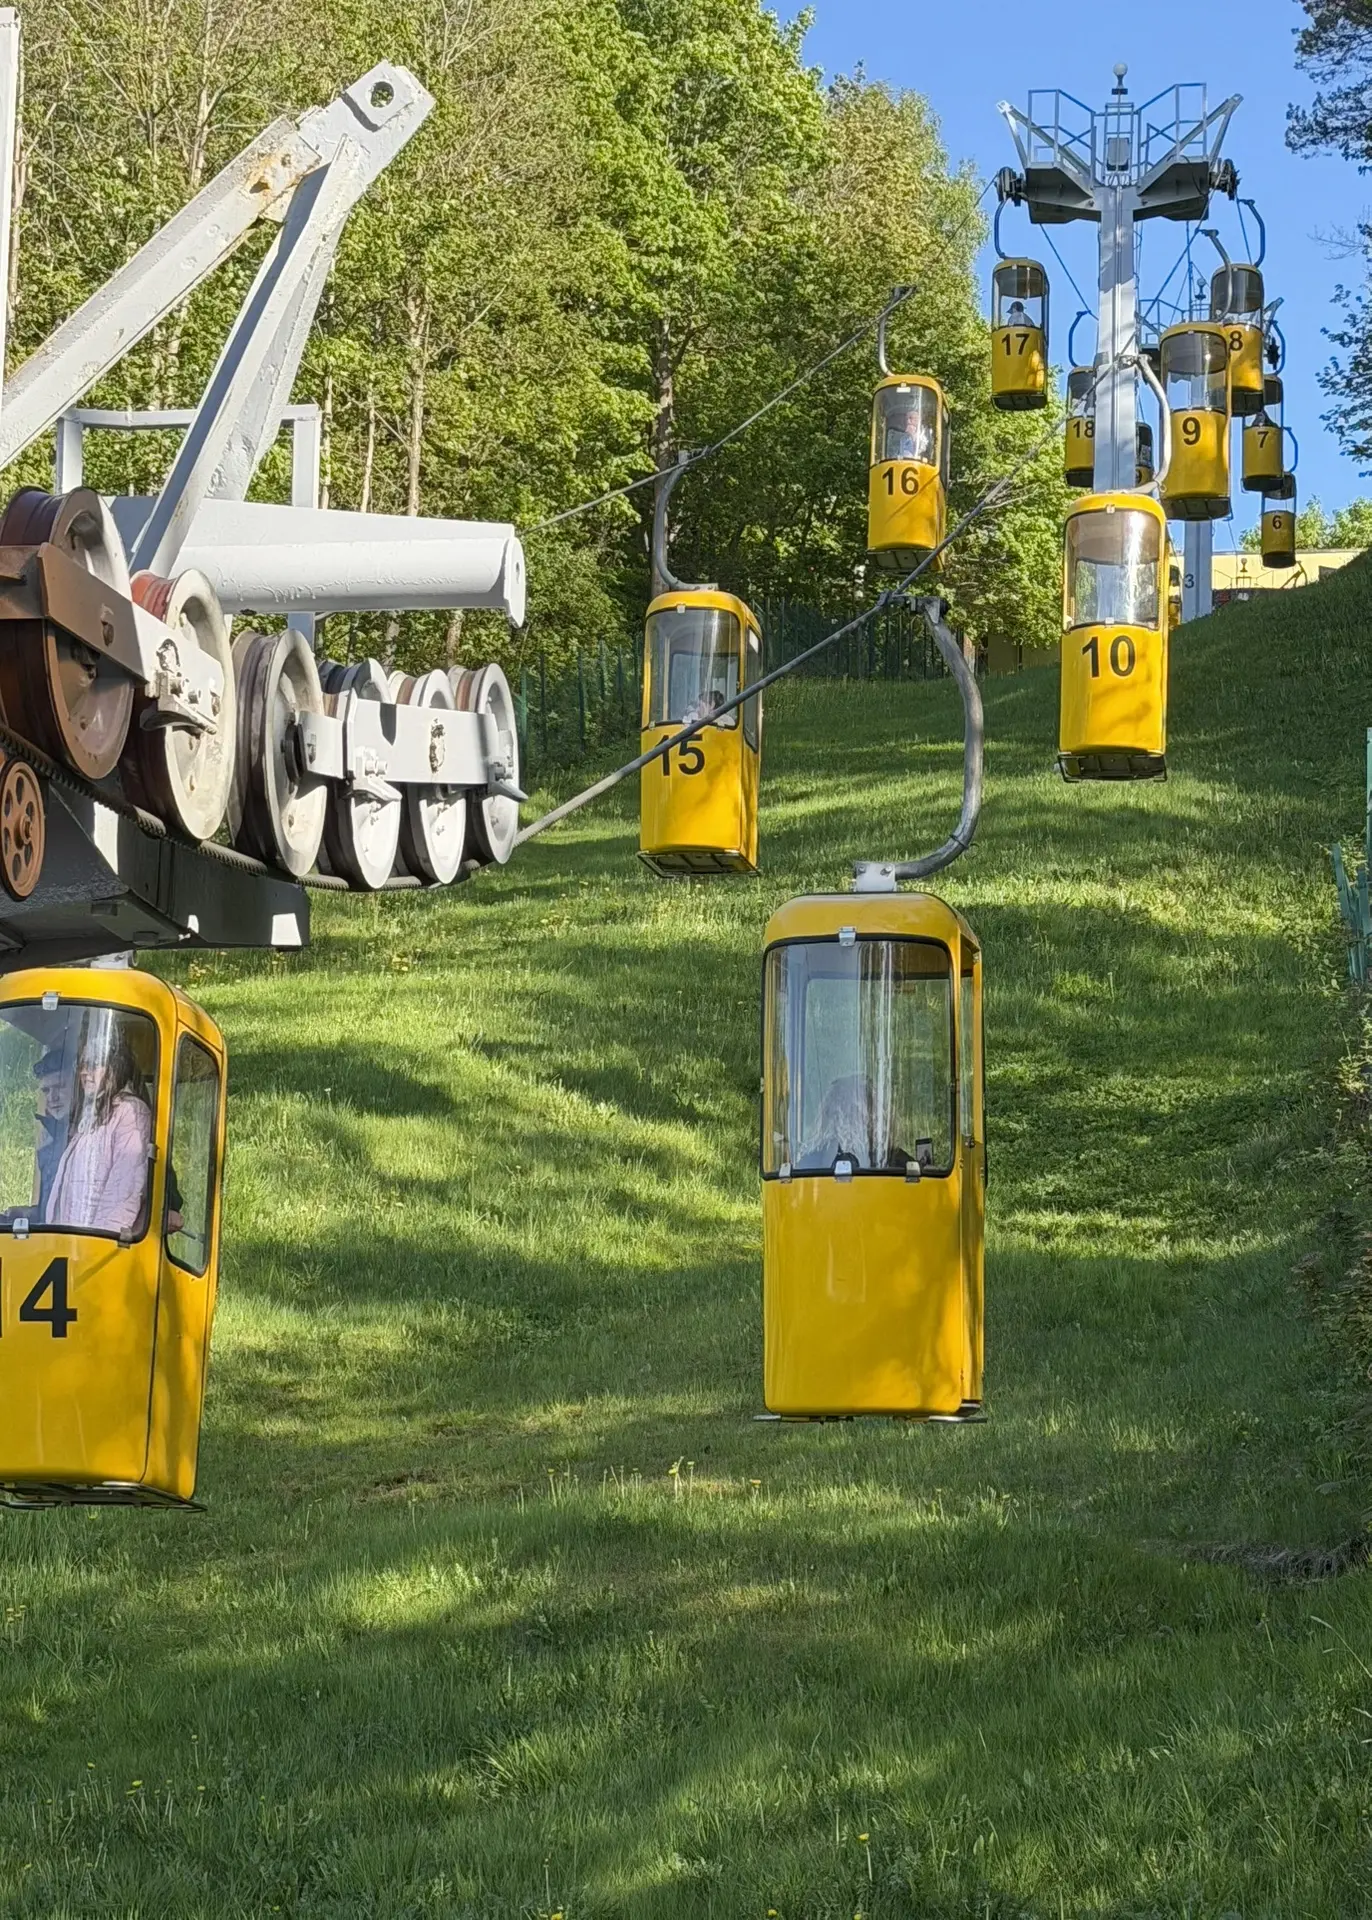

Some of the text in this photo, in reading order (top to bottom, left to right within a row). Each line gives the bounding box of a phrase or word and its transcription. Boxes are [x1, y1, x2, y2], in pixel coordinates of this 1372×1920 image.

[1002, 333, 1030, 355] 17
[1230, 330, 1243, 351] 8
[1073, 420, 1095, 438] 18
[1182, 417, 1201, 446] 9
[1257, 431, 1269, 448] 7
[882, 466, 919, 495] 16
[1272, 515, 1282, 530] 6
[1184, 573, 1195, 589] 3
[1082, 635, 1136, 678] 10
[654, 734, 705, 776] 15
[0, 1256, 78, 1338] 4
